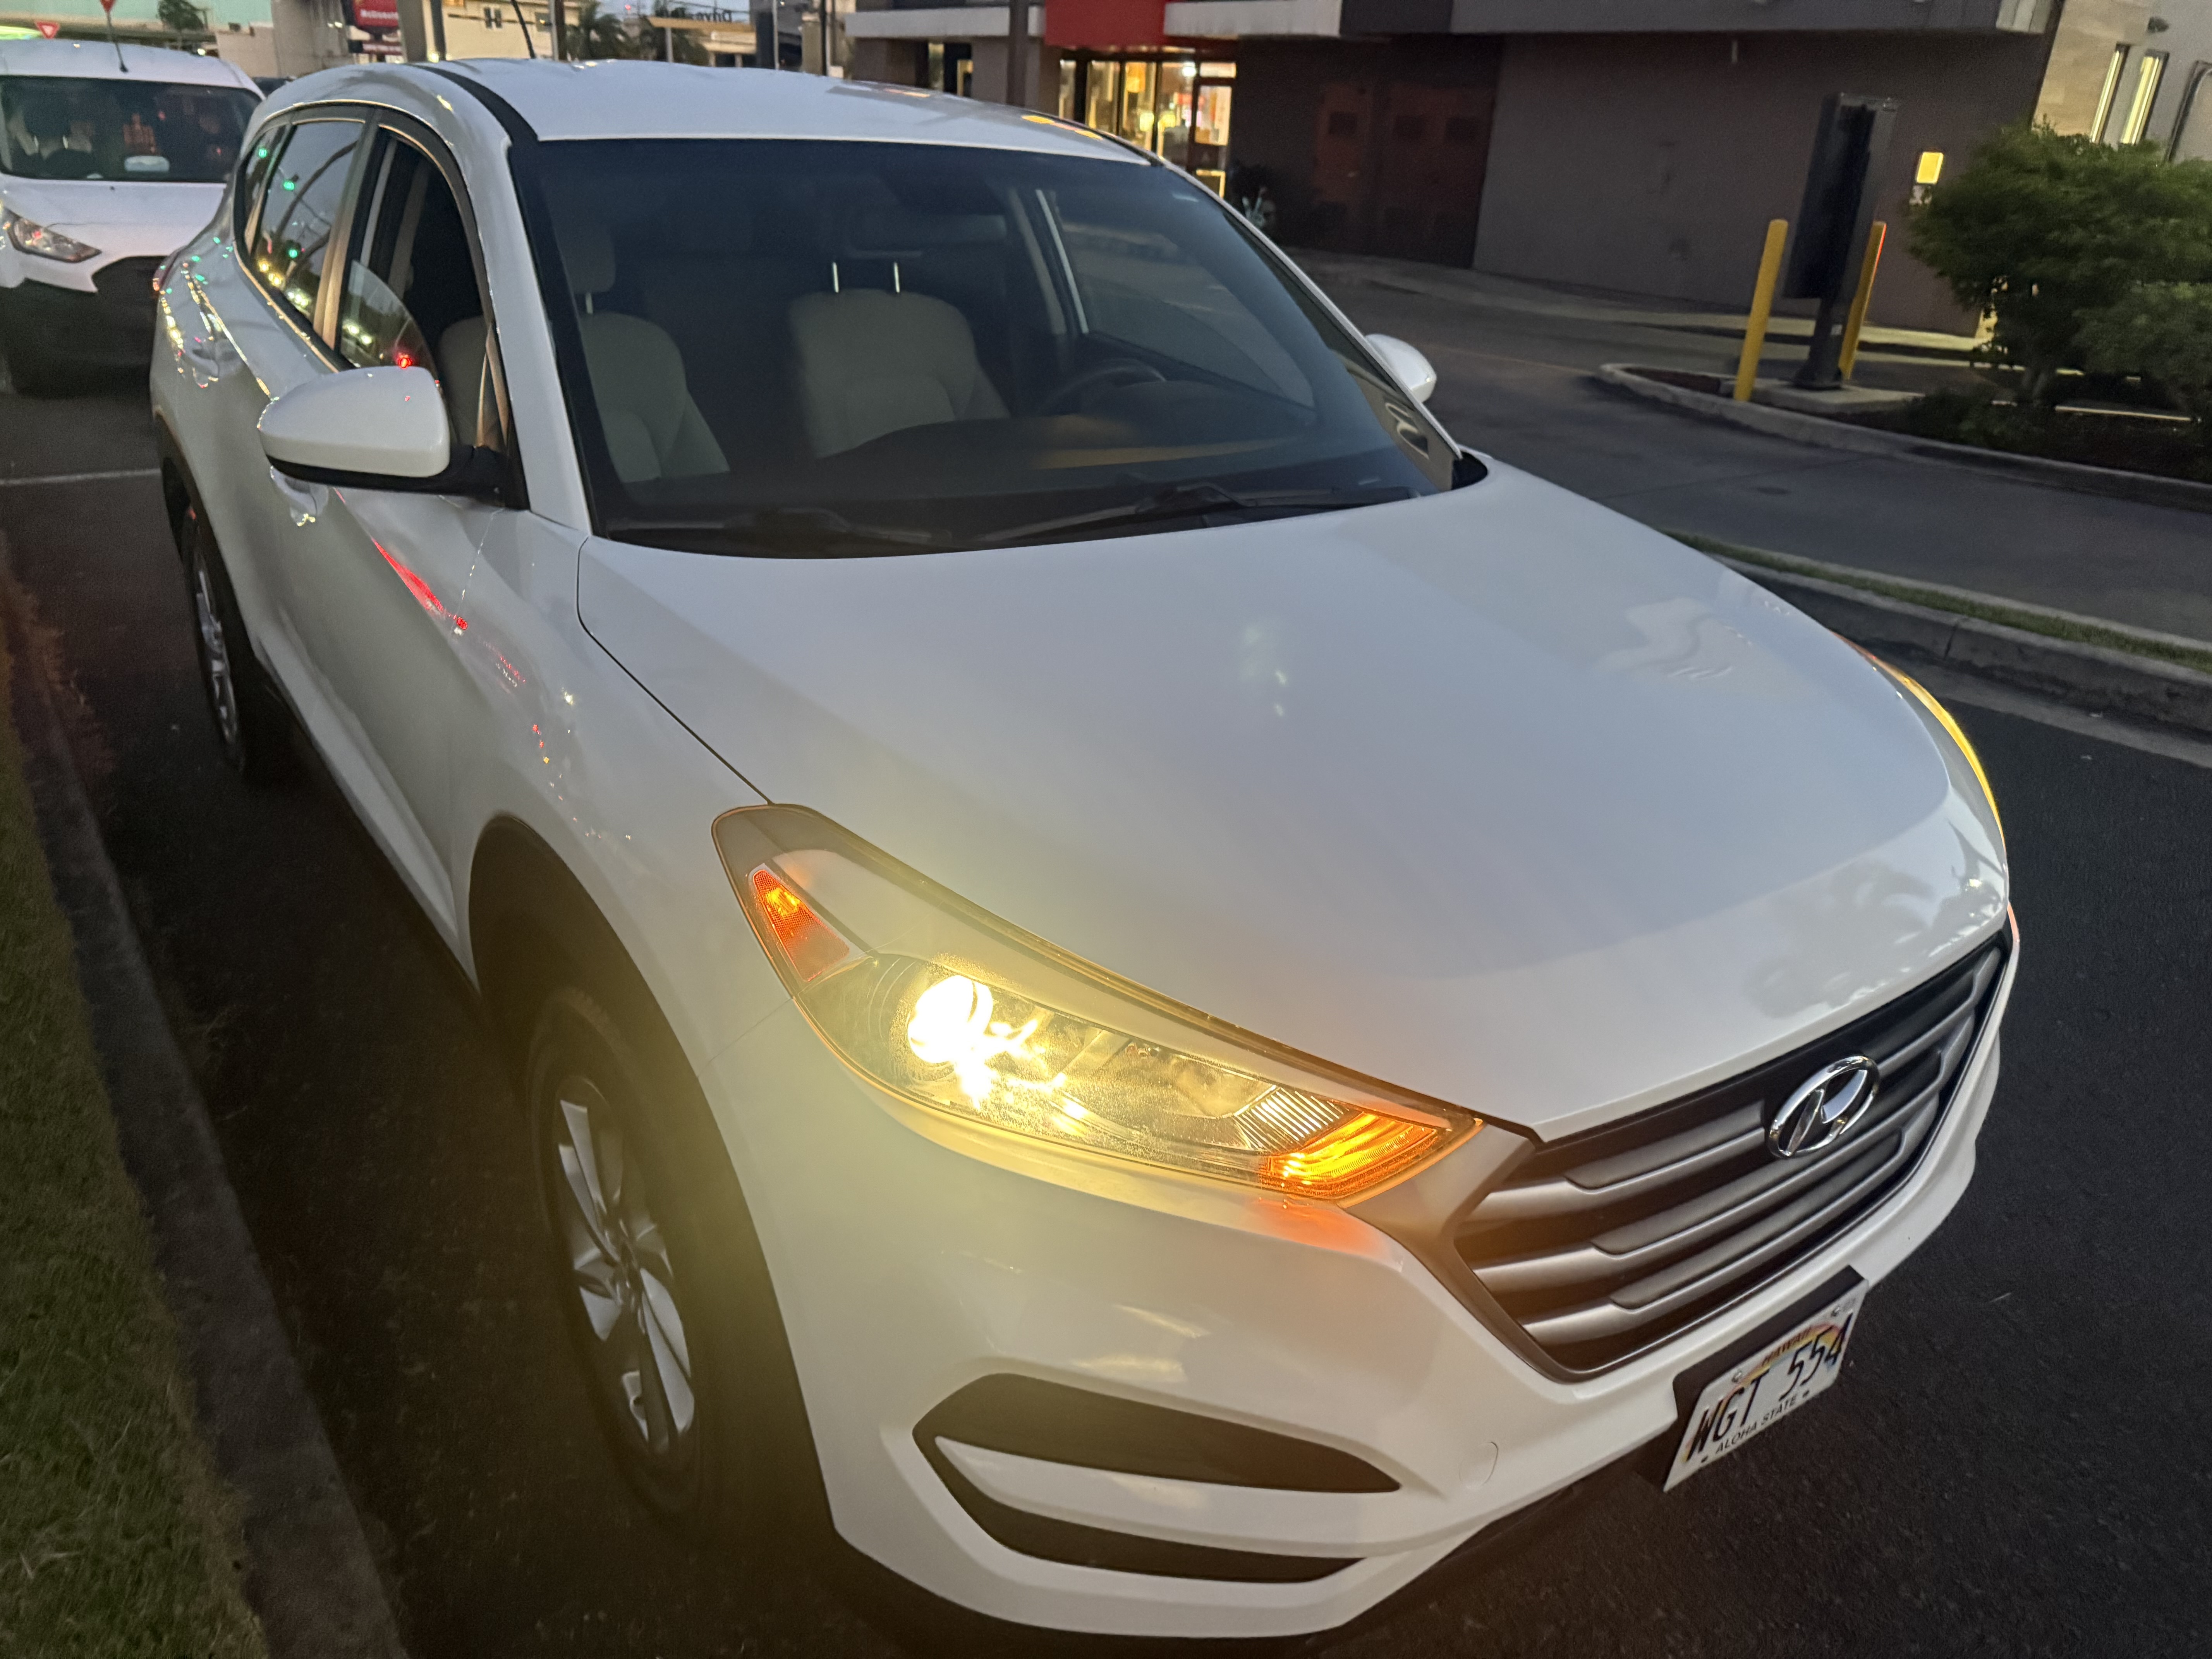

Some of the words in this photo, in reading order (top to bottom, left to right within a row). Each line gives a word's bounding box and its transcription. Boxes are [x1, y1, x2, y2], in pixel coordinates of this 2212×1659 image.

[1686, 1367, 1770, 1462] WGT
[1779, 1312, 1853, 1401] 554
[1716, 1421, 1757, 1453] ALOHA
[1761, 1394, 1798, 1425] STATE
